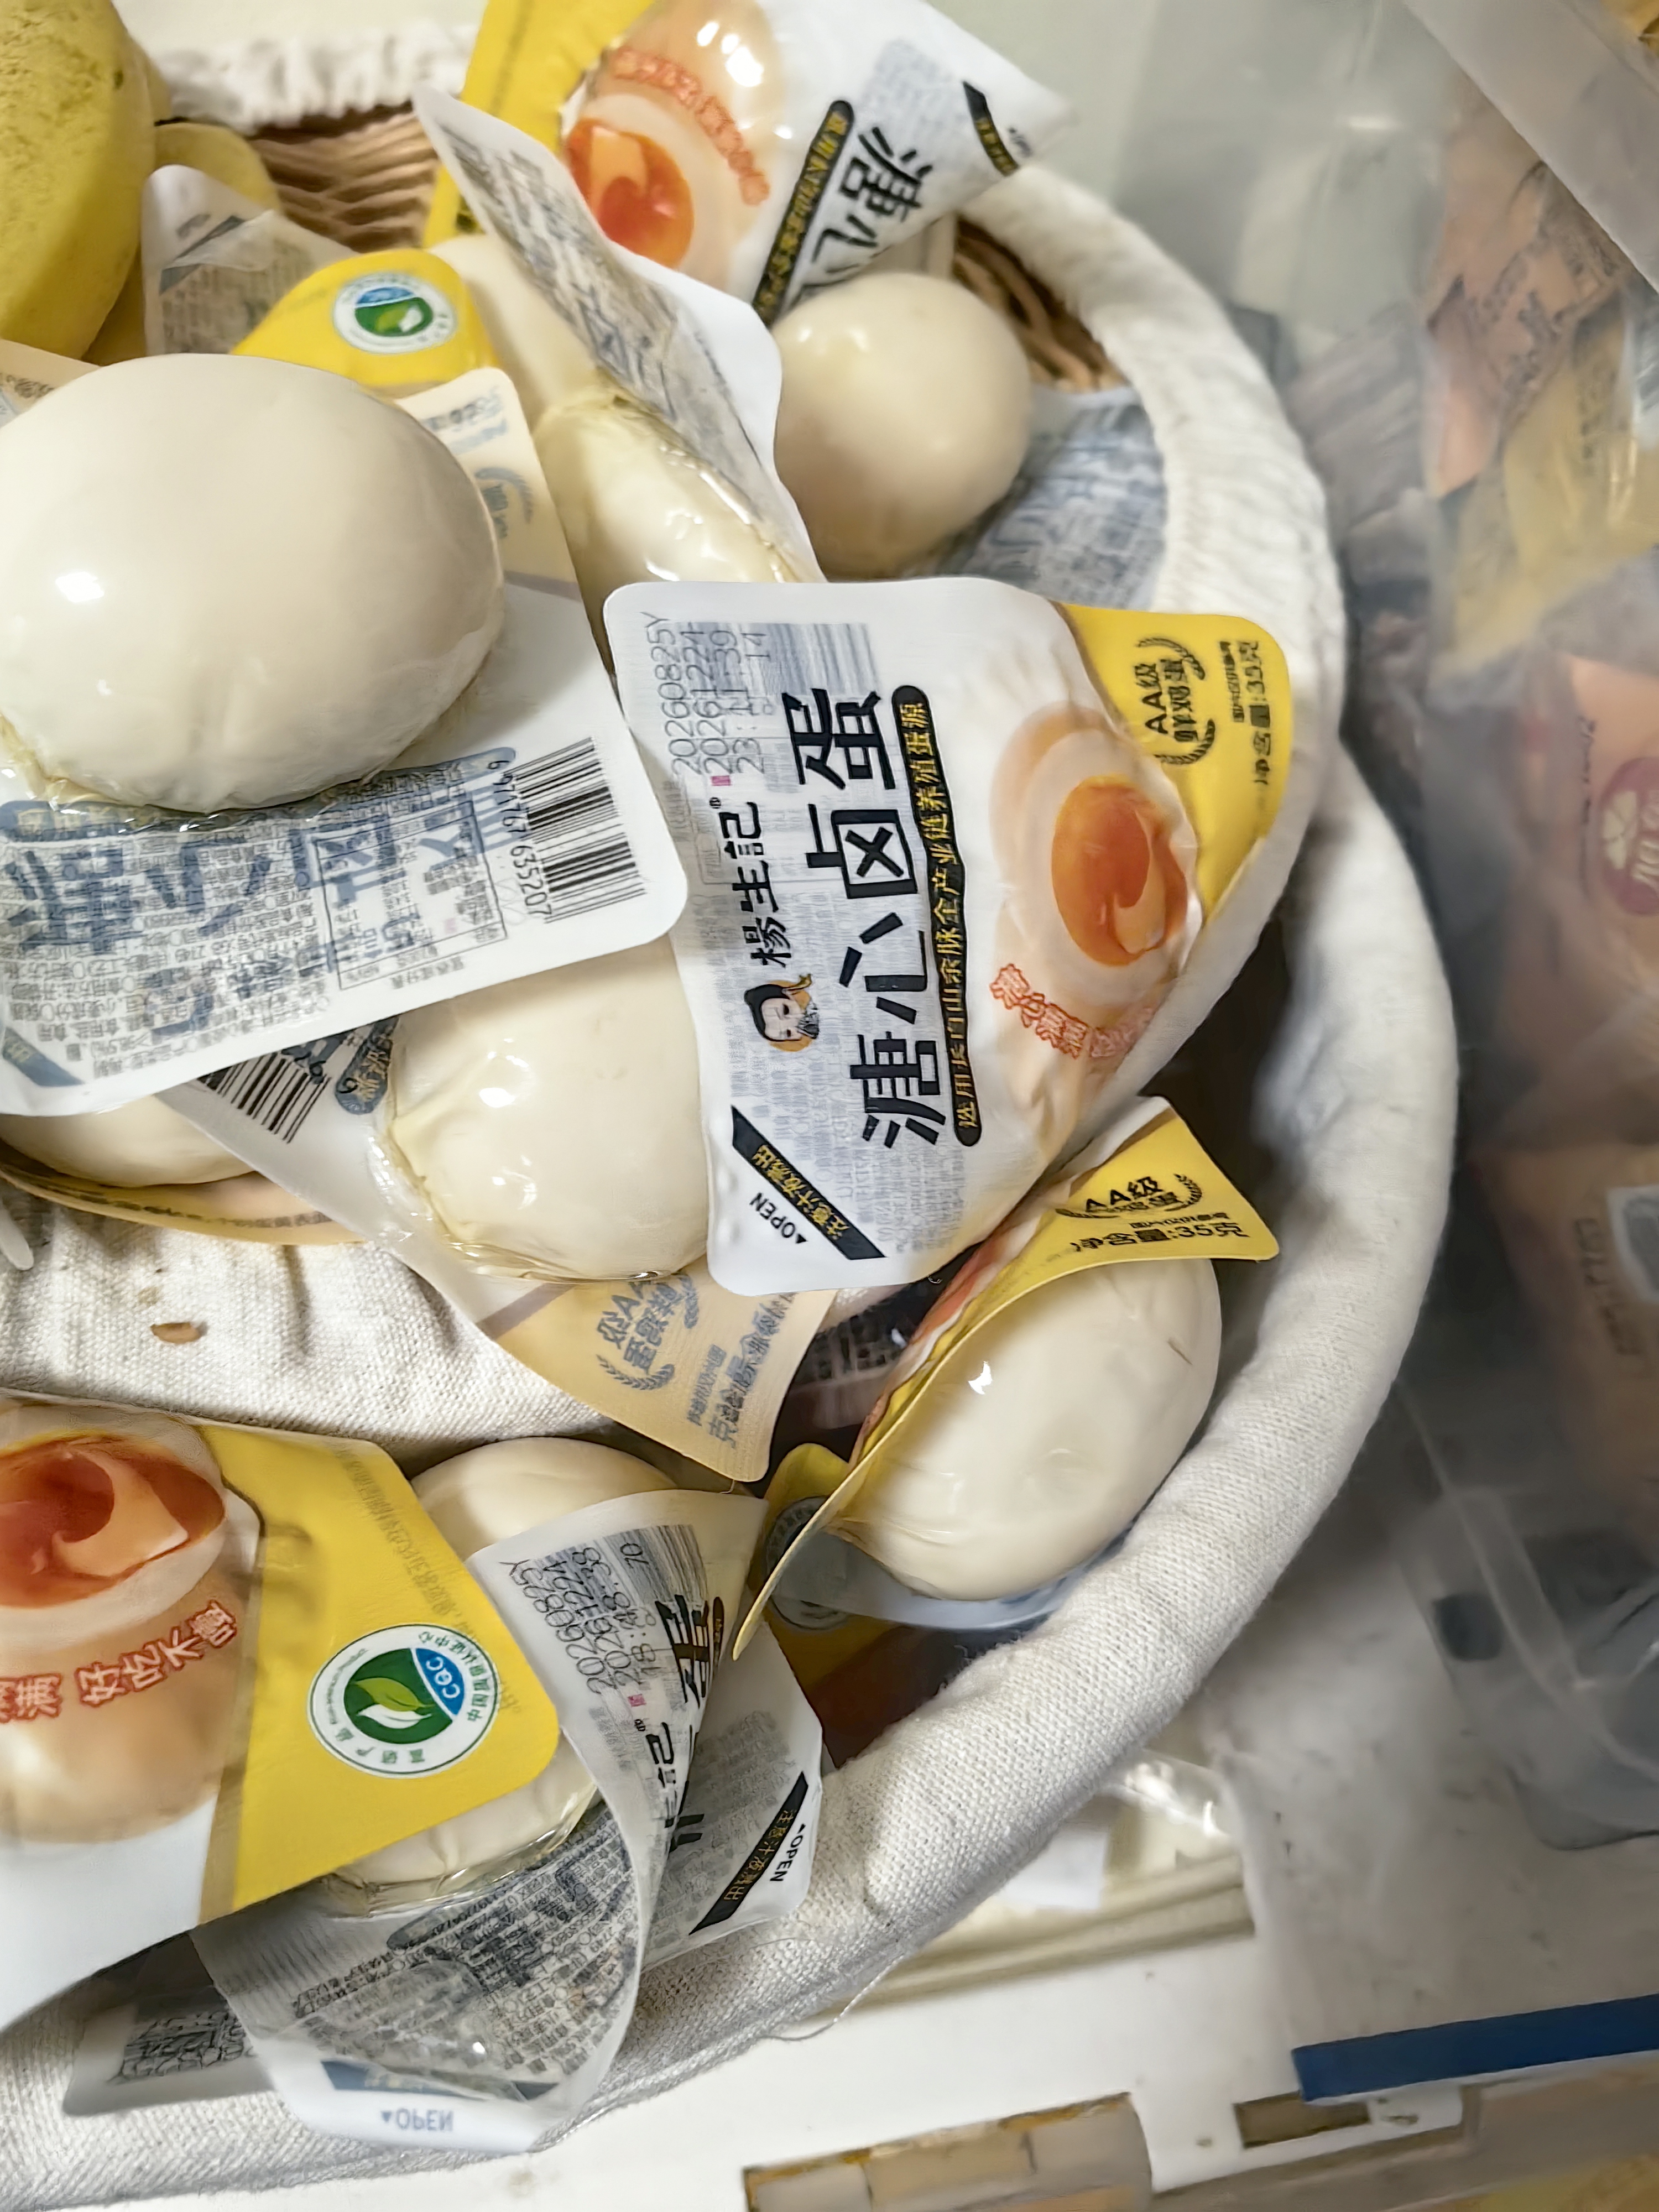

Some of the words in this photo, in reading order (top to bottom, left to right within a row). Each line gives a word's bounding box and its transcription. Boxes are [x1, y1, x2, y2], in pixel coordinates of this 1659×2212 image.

[640, 612, 702, 774] 20260825Y
[679, 631, 733, 774] 20261224
[1134, 664, 1168, 734] AA级
[509, 846, 553, 918] 635207
[723, 801, 792, 967] 楊生記
[781, 687, 947, 1150] 溏心卤蛋
[750, 1192, 796, 1238] OPEN
[1086, 1176, 1163, 1212] AA级
[498, 1559, 616, 1694] 20260825Y
[426, 1656, 461, 1698] CQC
[771, 1834, 804, 1883] OPEN
